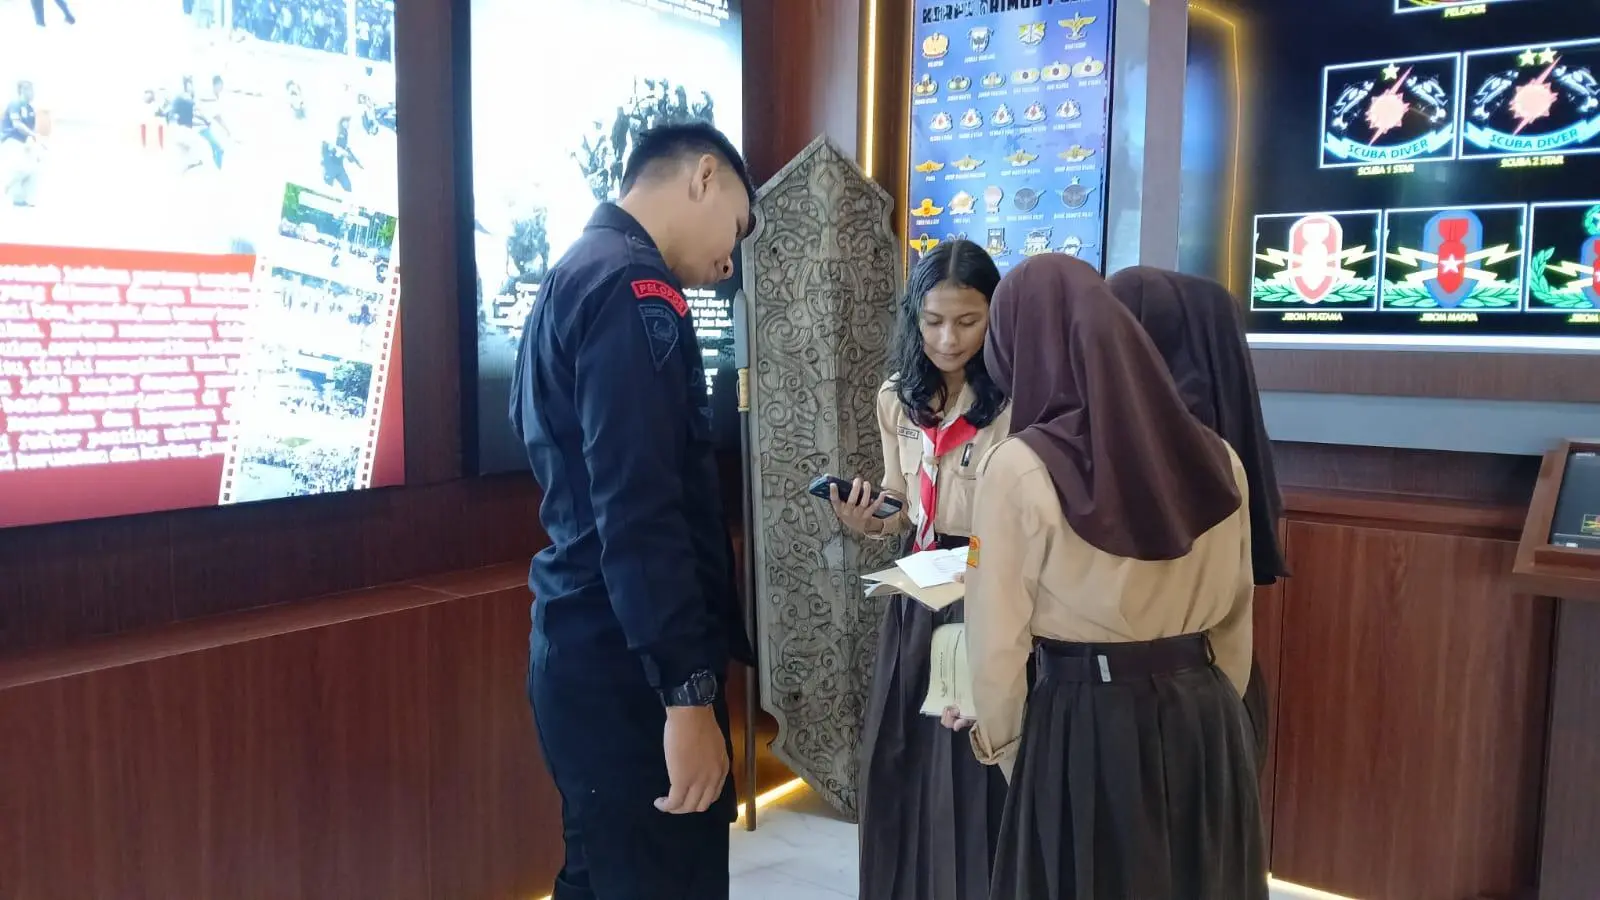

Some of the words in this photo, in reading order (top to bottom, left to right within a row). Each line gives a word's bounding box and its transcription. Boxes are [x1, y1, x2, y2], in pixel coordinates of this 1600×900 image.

[1490, 134, 1533, 149] SCUBA
[1537, 128, 1578, 147] DIVER
[1348, 144, 1387, 159] SCUBA
[1391, 138, 1428, 158] DIVER
[1357, 165, 1385, 176] SCUBA
[1386, 164, 1392, 174] 1
[1393, 163, 1415, 174] STAR
[1500, 156, 1531, 168] SCUBA
[1532, 156, 1539, 166] 2
[1540, 155, 1564, 166] STAR
[639, 282, 686, 313] PELOPOR
[1306, 312, 1343, 321] PRATAMA
